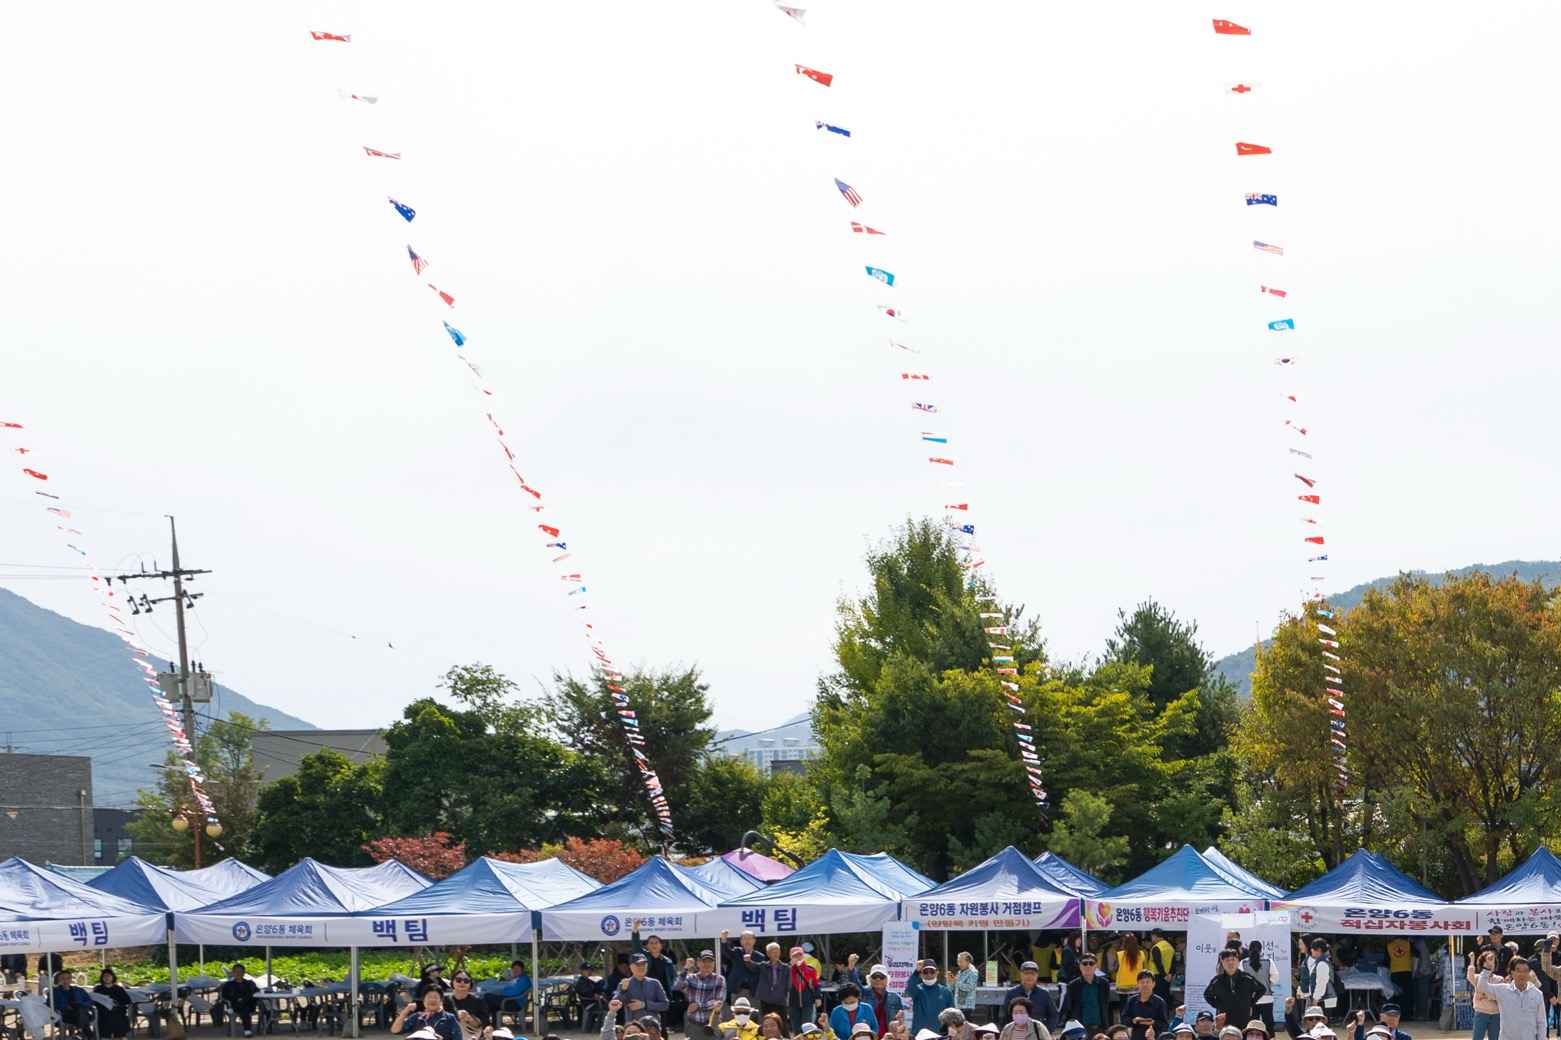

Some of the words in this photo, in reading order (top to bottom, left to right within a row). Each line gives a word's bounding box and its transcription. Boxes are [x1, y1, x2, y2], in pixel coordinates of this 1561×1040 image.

[920, 902, 957, 917] 온양6동
[960, 902, 1000, 917] 자원봉사
[1002, 901, 1043, 915] 거점캠프
[1115, 907, 1143, 923] 온양6동
[1143, 906, 1190, 923] 행복키움추진단
[1343, 907, 1435, 920] 온양6동
[255, 924, 286, 935] 온양6동
[289, 923, 313, 935] 체육회
[624, 917, 656, 928] 온6동
